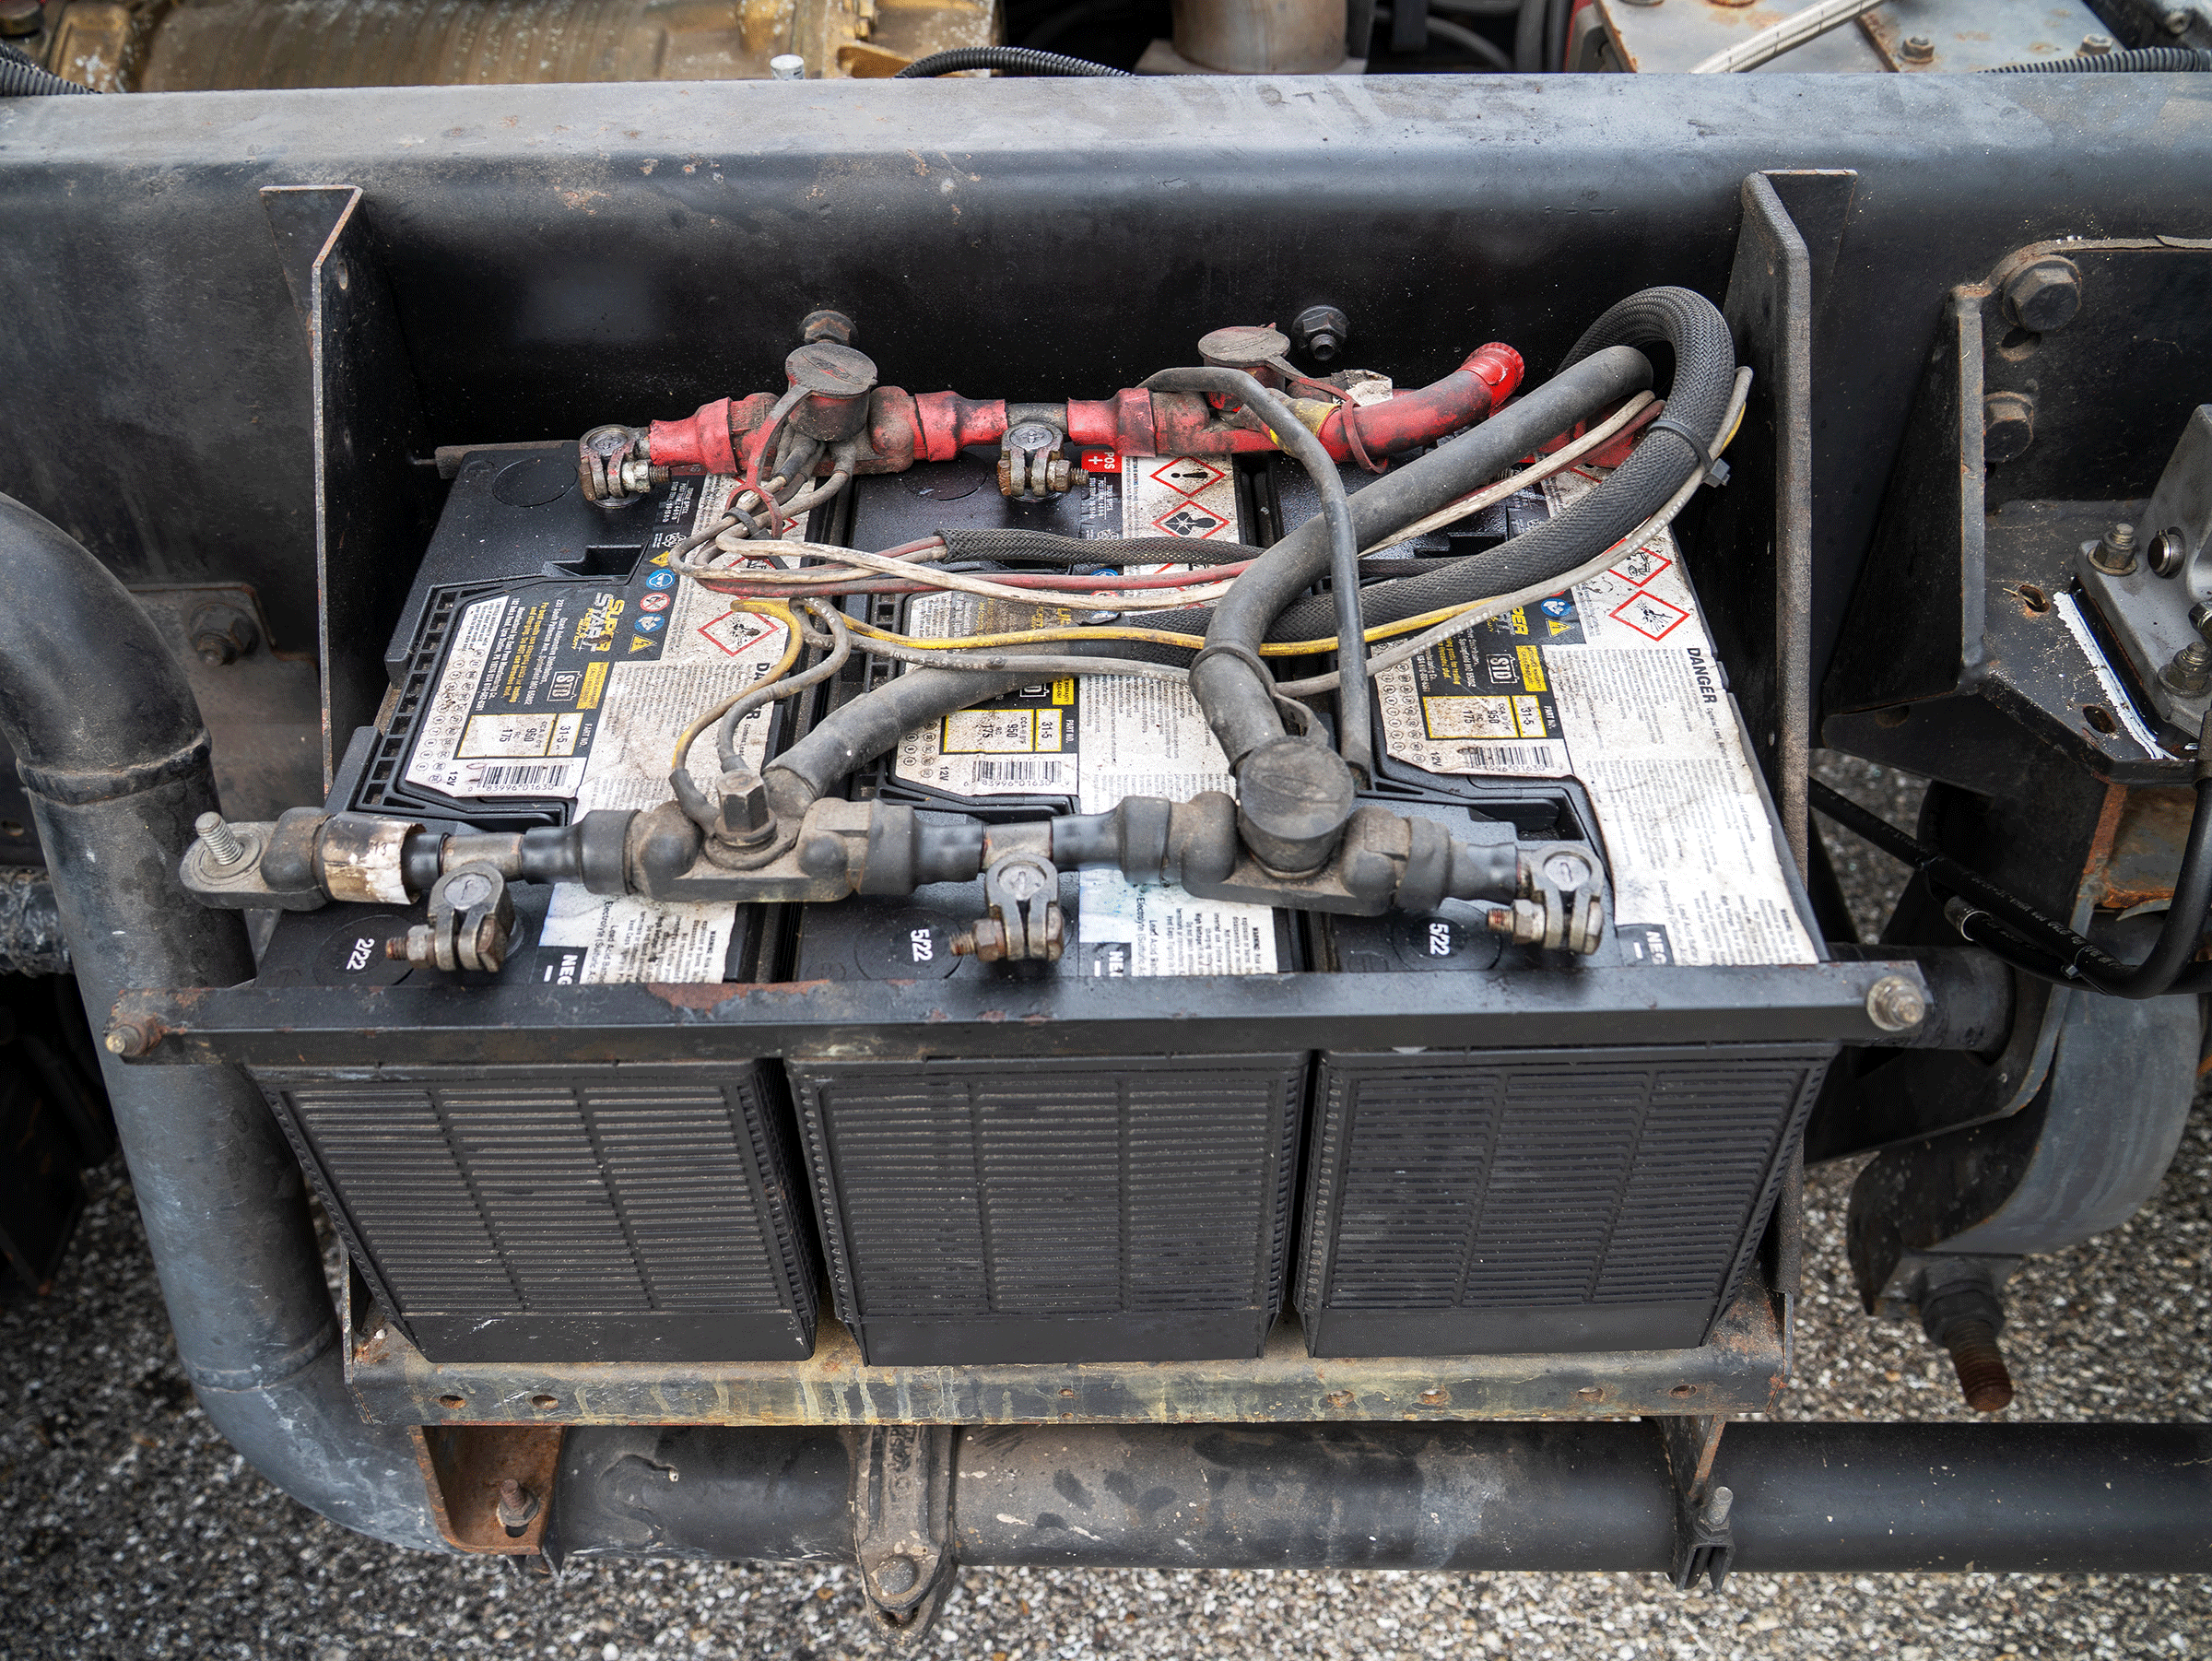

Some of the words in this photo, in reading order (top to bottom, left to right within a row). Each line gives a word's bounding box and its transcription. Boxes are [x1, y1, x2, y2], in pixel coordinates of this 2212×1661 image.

[1104, 452, 1115, 469] POS
[582, 593, 614, 652] START
[595, 599, 625, 652] SUPER
[1512, 607, 1528, 635] PER
[517, 645, 527, 654] NOT
[571, 636, 580, 650] DUTY
[1458, 638, 1470, 663] Springfield
[522, 645, 534, 665] charging
[1438, 647, 1448, 666] threaded
[532, 655, 547, 679] Springfield
[1447, 648, 1455, 660] posts
[1453, 669, 1461, 684] testing
[1490, 658, 1512, 679] STD
[1687, 648, 1717, 703] DANGER
[509, 686, 522, 702] testing
[552, 675, 575, 697] STD
[747, 663, 770, 719] DAR
[1464, 711, 1475, 723] 175
[1488, 711, 1500, 724] 950
[1521, 708, 1534, 724] 31-5
[1544, 706, 1554, 719] PART
[582, 724, 593, 735] PART
[982, 725, 993, 737] 175
[1006, 724, 1018, 737] 950
[1041, 722, 1053, 738] 31-5
[1547, 720, 1556, 729] NO.
[500, 728, 512, 742] 175
[524, 728, 536, 742] 950
[557, 726, 571, 743] 31-5
[579, 736, 588, 747] NO.
[1065, 734, 1074, 743] NO.
[1431, 752, 1441, 766] 12V
[446, 771, 458, 785] 12V
[940, 766, 948, 781] 12V
[597, 901, 613, 937] Electrolyte
[1135, 898, 1146, 931] Electrolyte
[608, 925, 618, 941] Lead
[1149, 920, 1158, 936] Lead
[911, 928, 933, 961] 5/22
[1149, 938, 1158, 955] Acid
[1430, 923, 1450, 955] 5/22
[346, 938, 375, 970] 2/22
[606, 944, 615, 959] Acid
[1646, 931, 1666, 965] NEG
[557, 955, 578, 984] NEG
